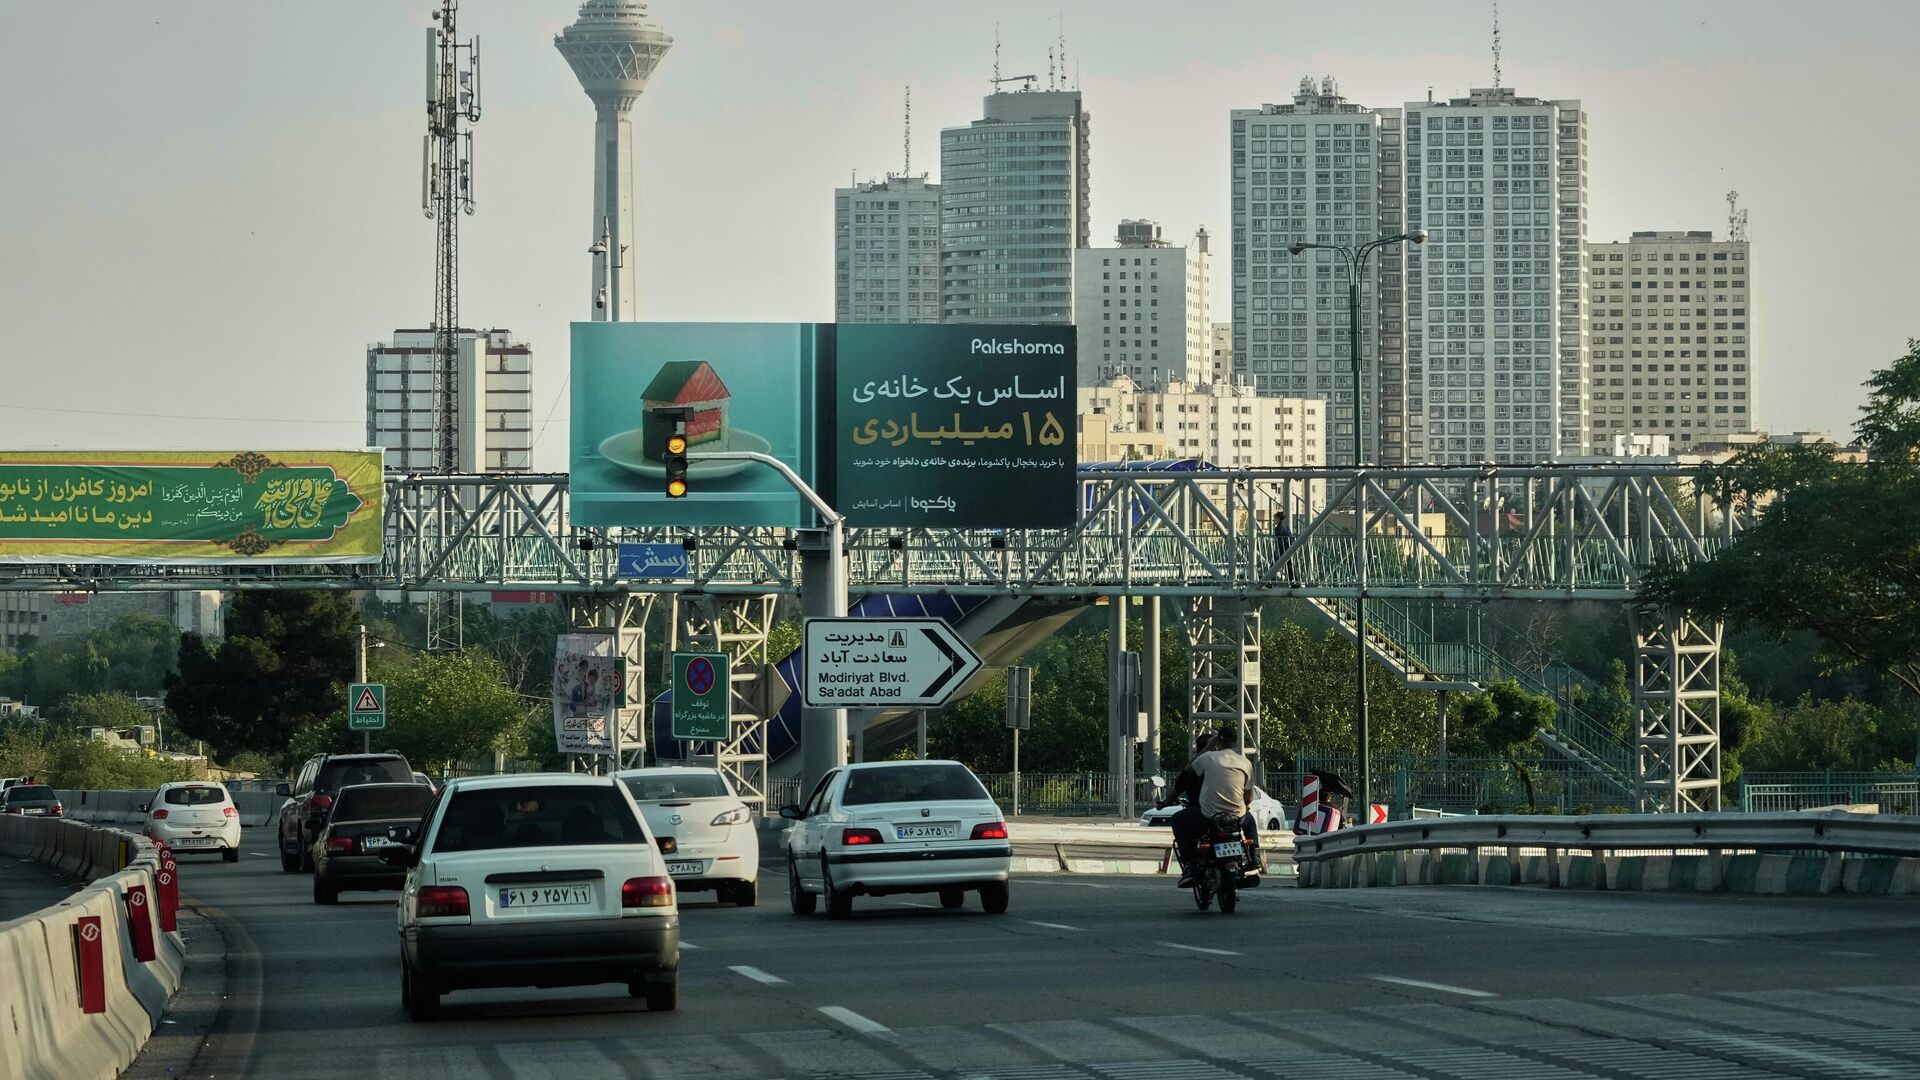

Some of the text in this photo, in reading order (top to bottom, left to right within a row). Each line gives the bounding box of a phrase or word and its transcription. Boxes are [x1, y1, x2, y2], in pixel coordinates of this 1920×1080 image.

[971, 338, 1064, 355] Pakshoma
[933, 375, 971, 404] یک
[977, 375, 1064, 406] اساس
[852, 410, 1064, 446] ۱۵ میلیاردی
[852, 458, 873, 468] شوید
[874, 457, 891, 468] خود
[892, 457, 919, 468] دلخواه
[1012, 457, 1038, 469] یخچال
[1039, 458, 1057, 468] خرید
[1058, 457, 1065, 468] با
[32, 477, 48, 501] از
[51, 476, 105, 502] کافران
[104, 479, 153, 503] امروز
[852, 498, 901, 509] اساس آسایش
[91, 505, 116, 523] ما
[117, 509, 153, 529] دین
[824, 632, 884, 646] مدیریت
[820, 650, 907, 668] سعادت آباد
[818, 672, 910, 685] Modiriyat Blvd.
[818, 686, 901, 698] Sa'adat Abad
[691, 699, 709, 710] توقف
[355, 715, 380, 725] احتیاط
[716, 714, 725, 722] در
[543, 888, 569, 904] ۲۵۷
